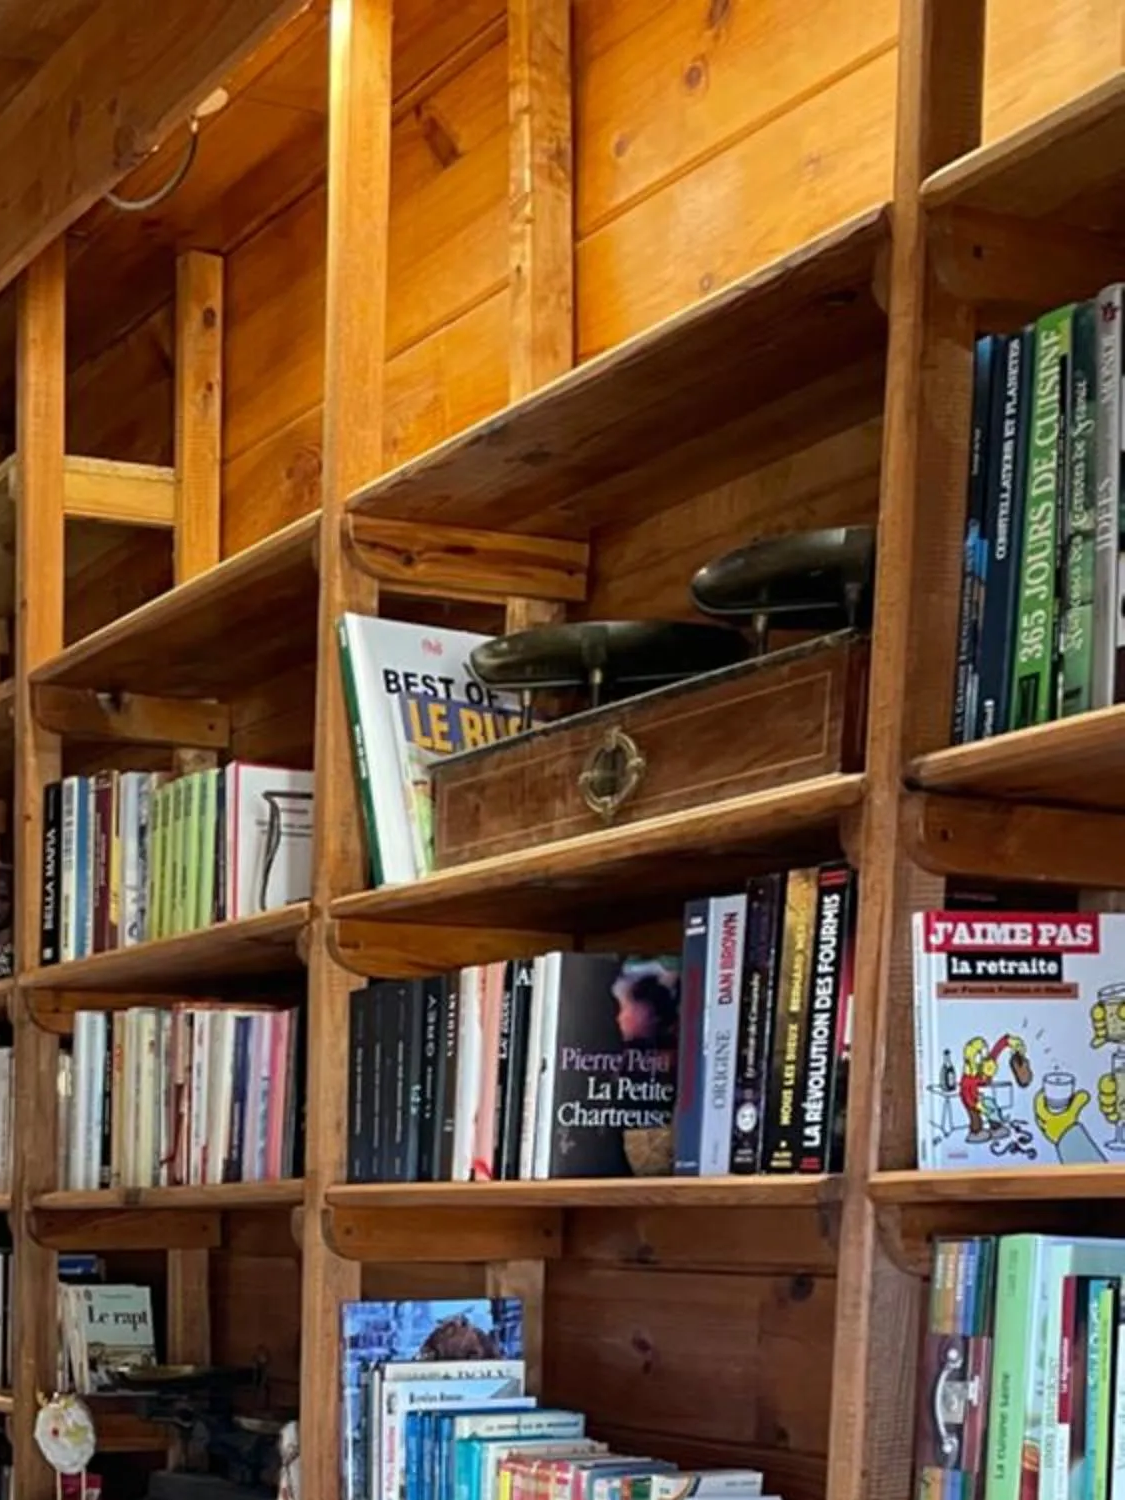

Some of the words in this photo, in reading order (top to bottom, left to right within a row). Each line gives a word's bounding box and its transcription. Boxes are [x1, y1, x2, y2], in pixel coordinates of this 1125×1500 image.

[1034, 329, 1063, 447] CUISINE
[1002, 417, 1017, 437] ET
[1032, 458, 1056, 495] DE
[1026, 501, 1054, 601] JOURS
[1018, 610, 1046, 663] 365
[383, 669, 455, 700] BEST
[465, 681, 503, 708] OF
[409, 698, 452, 753] LE
[44, 882, 55, 930] BELLA
[718, 911, 738, 971] BROWN
[817, 893, 841, 974] FOURMIS
[929, 923, 1034, 946] J'AIME
[1038, 923, 1094, 945] PAS
[951, 959, 972, 975] la
[975, 958, 1059, 975] retraite
[718, 974, 735, 1006] DAN
[815, 976, 835, 1009] DES
[425, 993, 437, 1058] GREY
[561, 1047, 623, 1073] Pierre
[711, 1029, 732, 1110] ORIGINE
[802, 1012, 832, 1123] RÉVOLUTION
[587, 1076, 615, 1101] La
[618, 1077, 675, 1102] Petite
[558, 1102, 673, 1129] Chartreuse
[803, 1126, 822, 1148] LA
[87, 1306, 108, 1325] Le
[113, 1312, 149, 1331] rapt
